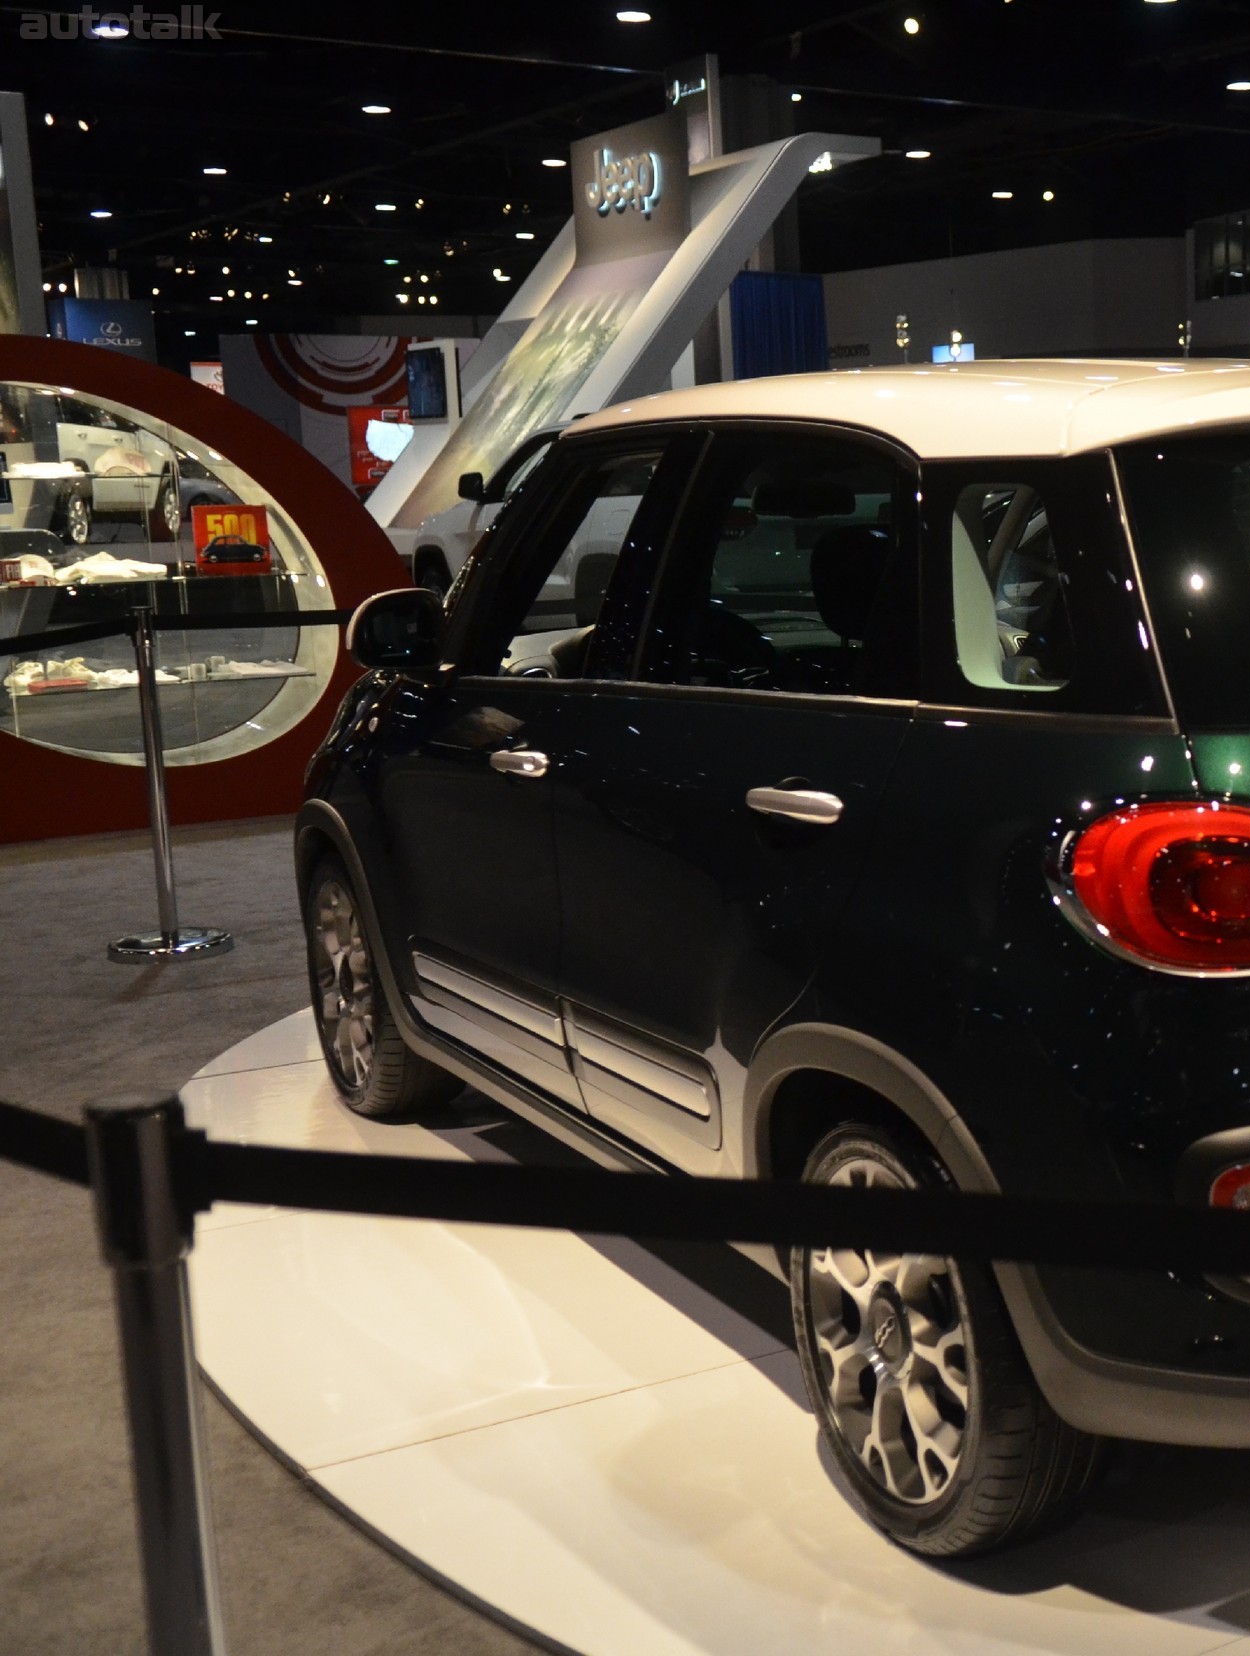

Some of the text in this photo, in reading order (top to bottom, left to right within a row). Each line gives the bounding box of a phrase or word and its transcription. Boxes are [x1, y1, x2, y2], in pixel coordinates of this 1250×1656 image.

[585, 149, 661, 213] Jeep
[83, 337, 142, 347] LEXUS
[206, 513, 258, 545] 500
